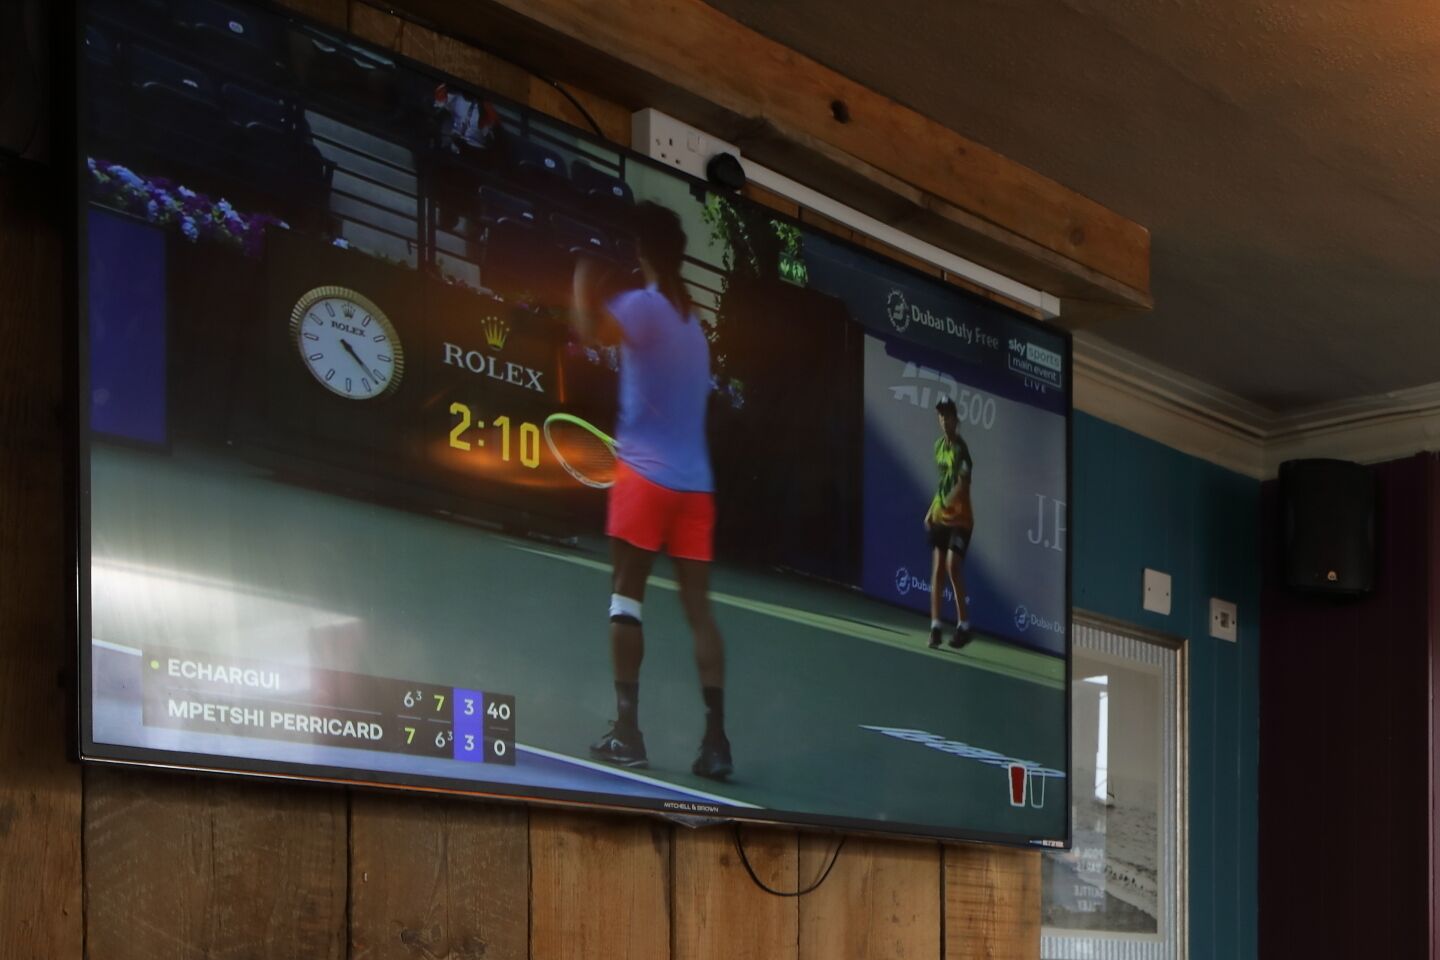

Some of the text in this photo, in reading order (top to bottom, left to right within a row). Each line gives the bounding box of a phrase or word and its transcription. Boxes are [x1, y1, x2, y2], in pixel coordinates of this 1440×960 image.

[331, 320, 366, 337] ROLEX
[911, 304, 999, 349] Dubai Duty Free
[443, 342, 544, 392] ROLEX
[1008, 338, 1061, 369] sky sports
[1012, 357, 1056, 381] main event
[1024, 377, 1047, 393] LIVE
[449, 402, 540, 468] 2:10
[168, 658, 280, 690] ECHARGUI
[434, 695, 445, 711] 7
[464, 699, 474, 715] 3
[487, 702, 511, 720] 40
[168, 699, 264, 728] MPETSHI
[270, 711, 383, 740] PERRICARD
[404, 727, 416, 744] 7
[464, 735, 474, 751] 3
[494, 740, 506, 756] 0
